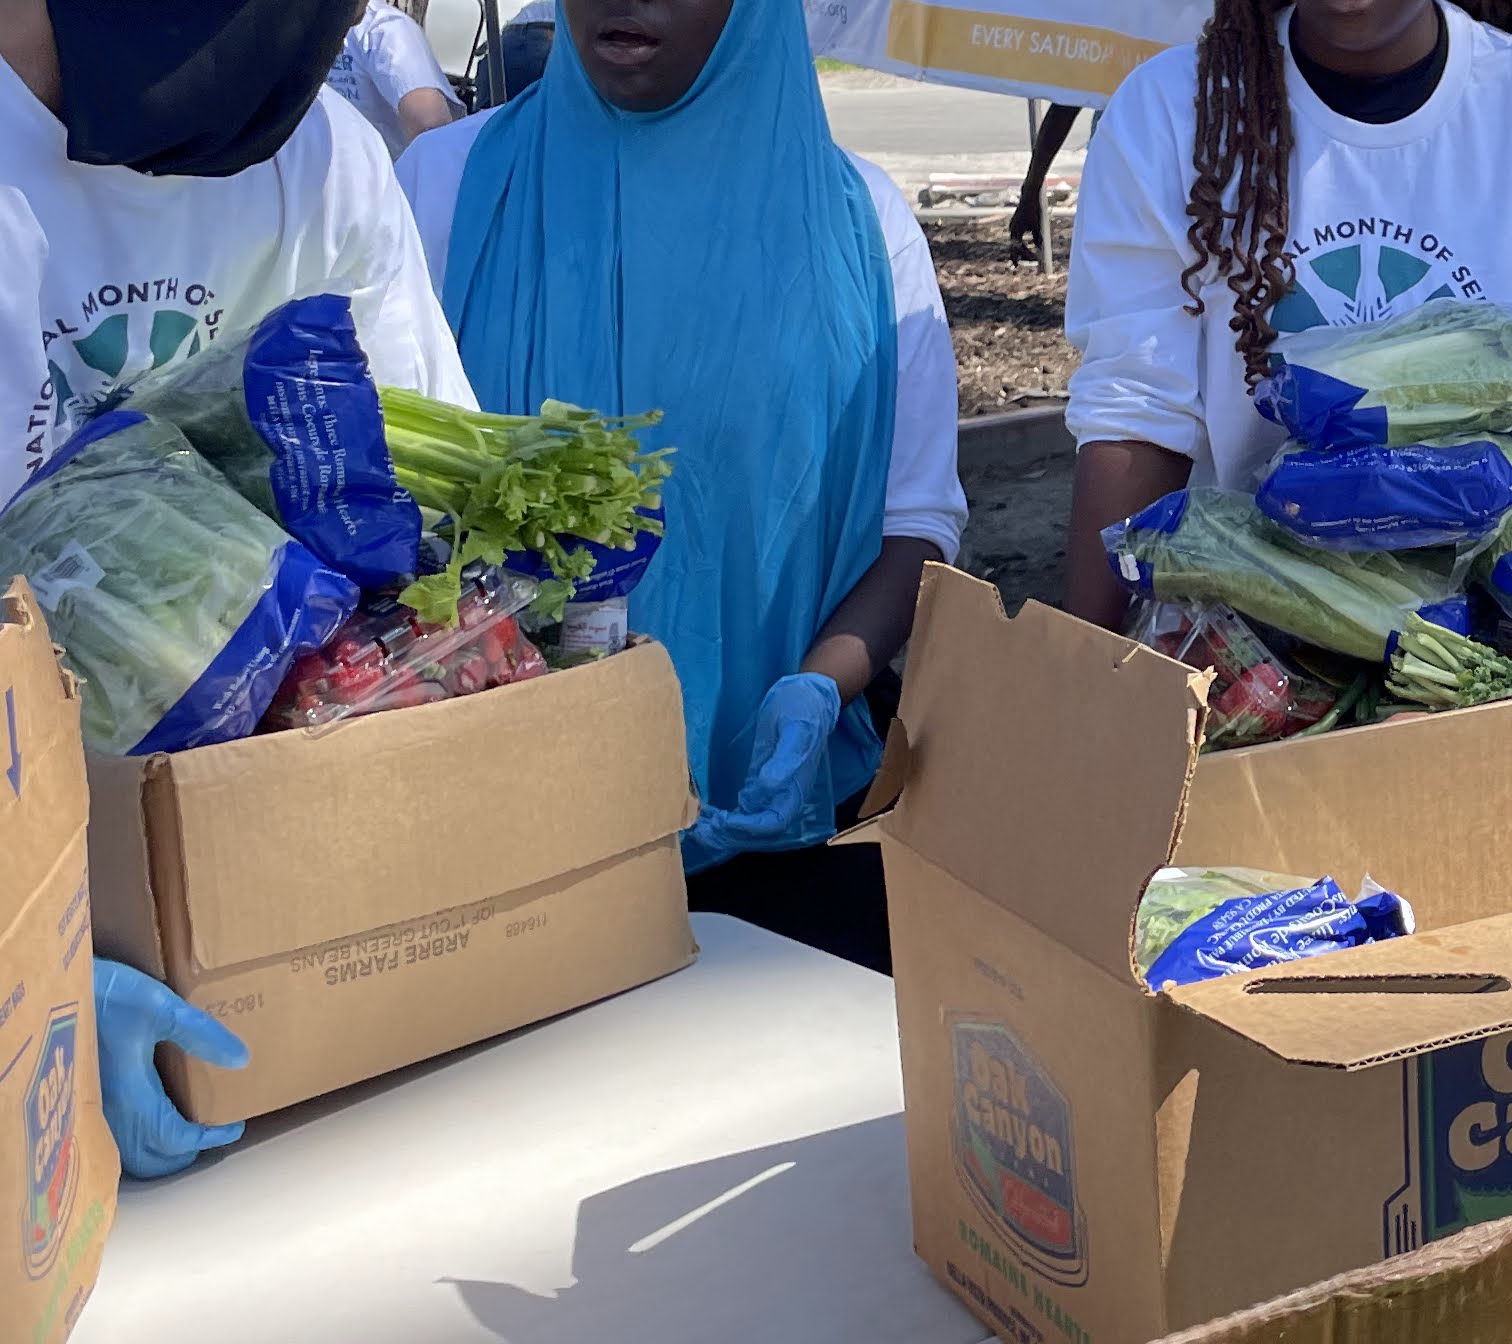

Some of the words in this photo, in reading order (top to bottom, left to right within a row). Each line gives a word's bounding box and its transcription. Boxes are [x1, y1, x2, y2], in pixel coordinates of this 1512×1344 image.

[971, 24, 1024, 50] EVERY
[1029, 32, 1113, 62] SATURD
[1313, 217, 1413, 246] MONTH
[1420, 234, 1454, 262] OF
[26, 318, 78, 474] NATIOAL
[81, 277, 179, 322] MONTH
[354, 925, 418, 955] GREEN
[405, 929, 471, 965] ARBRE
[420, 917, 451, 941] CUT
[290, 942, 351, 973] BEANS
[324, 951, 399, 986] FARMS
[971, 1040, 1030, 1115] Oak
